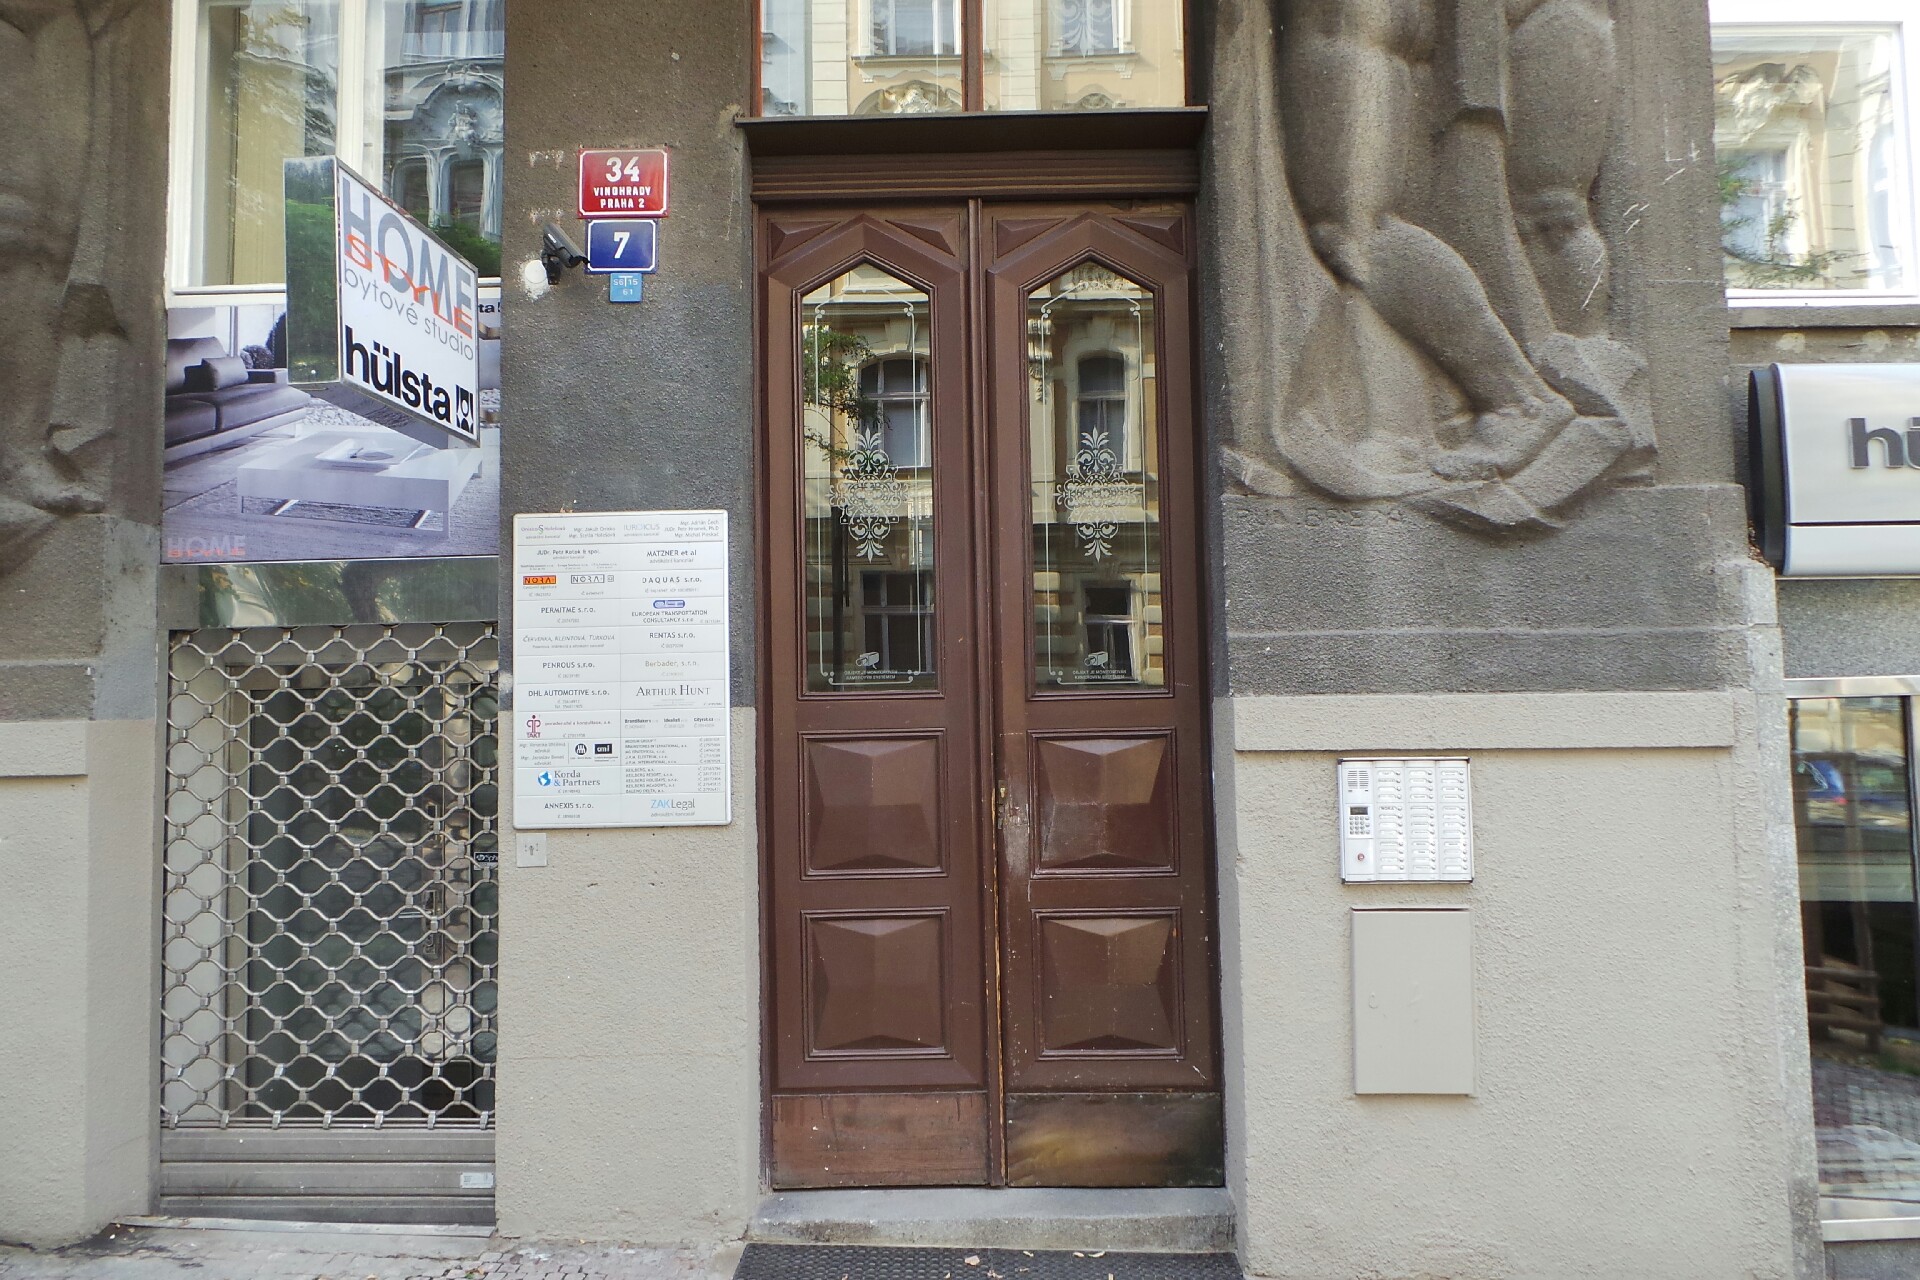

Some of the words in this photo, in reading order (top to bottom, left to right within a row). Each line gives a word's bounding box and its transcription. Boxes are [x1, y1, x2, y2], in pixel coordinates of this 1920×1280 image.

[605, 156, 640, 182] 34
[593, 186, 651, 196] VINOHRADY
[600, 198, 634, 208] PRAHA
[638, 198, 645, 208] 2
[343, 176, 472, 336] HOME
[613, 231, 631, 259] 7
[344, 233, 472, 339] STYLE
[344, 259, 418, 326] bytové
[424, 316, 474, 361] studio
[345, 324, 451, 424] hülsta
[544, 689, 589, 697] AUTOMOTIVE
[554, 770, 581, 778] Korda
[562, 778, 601, 786] Partners
